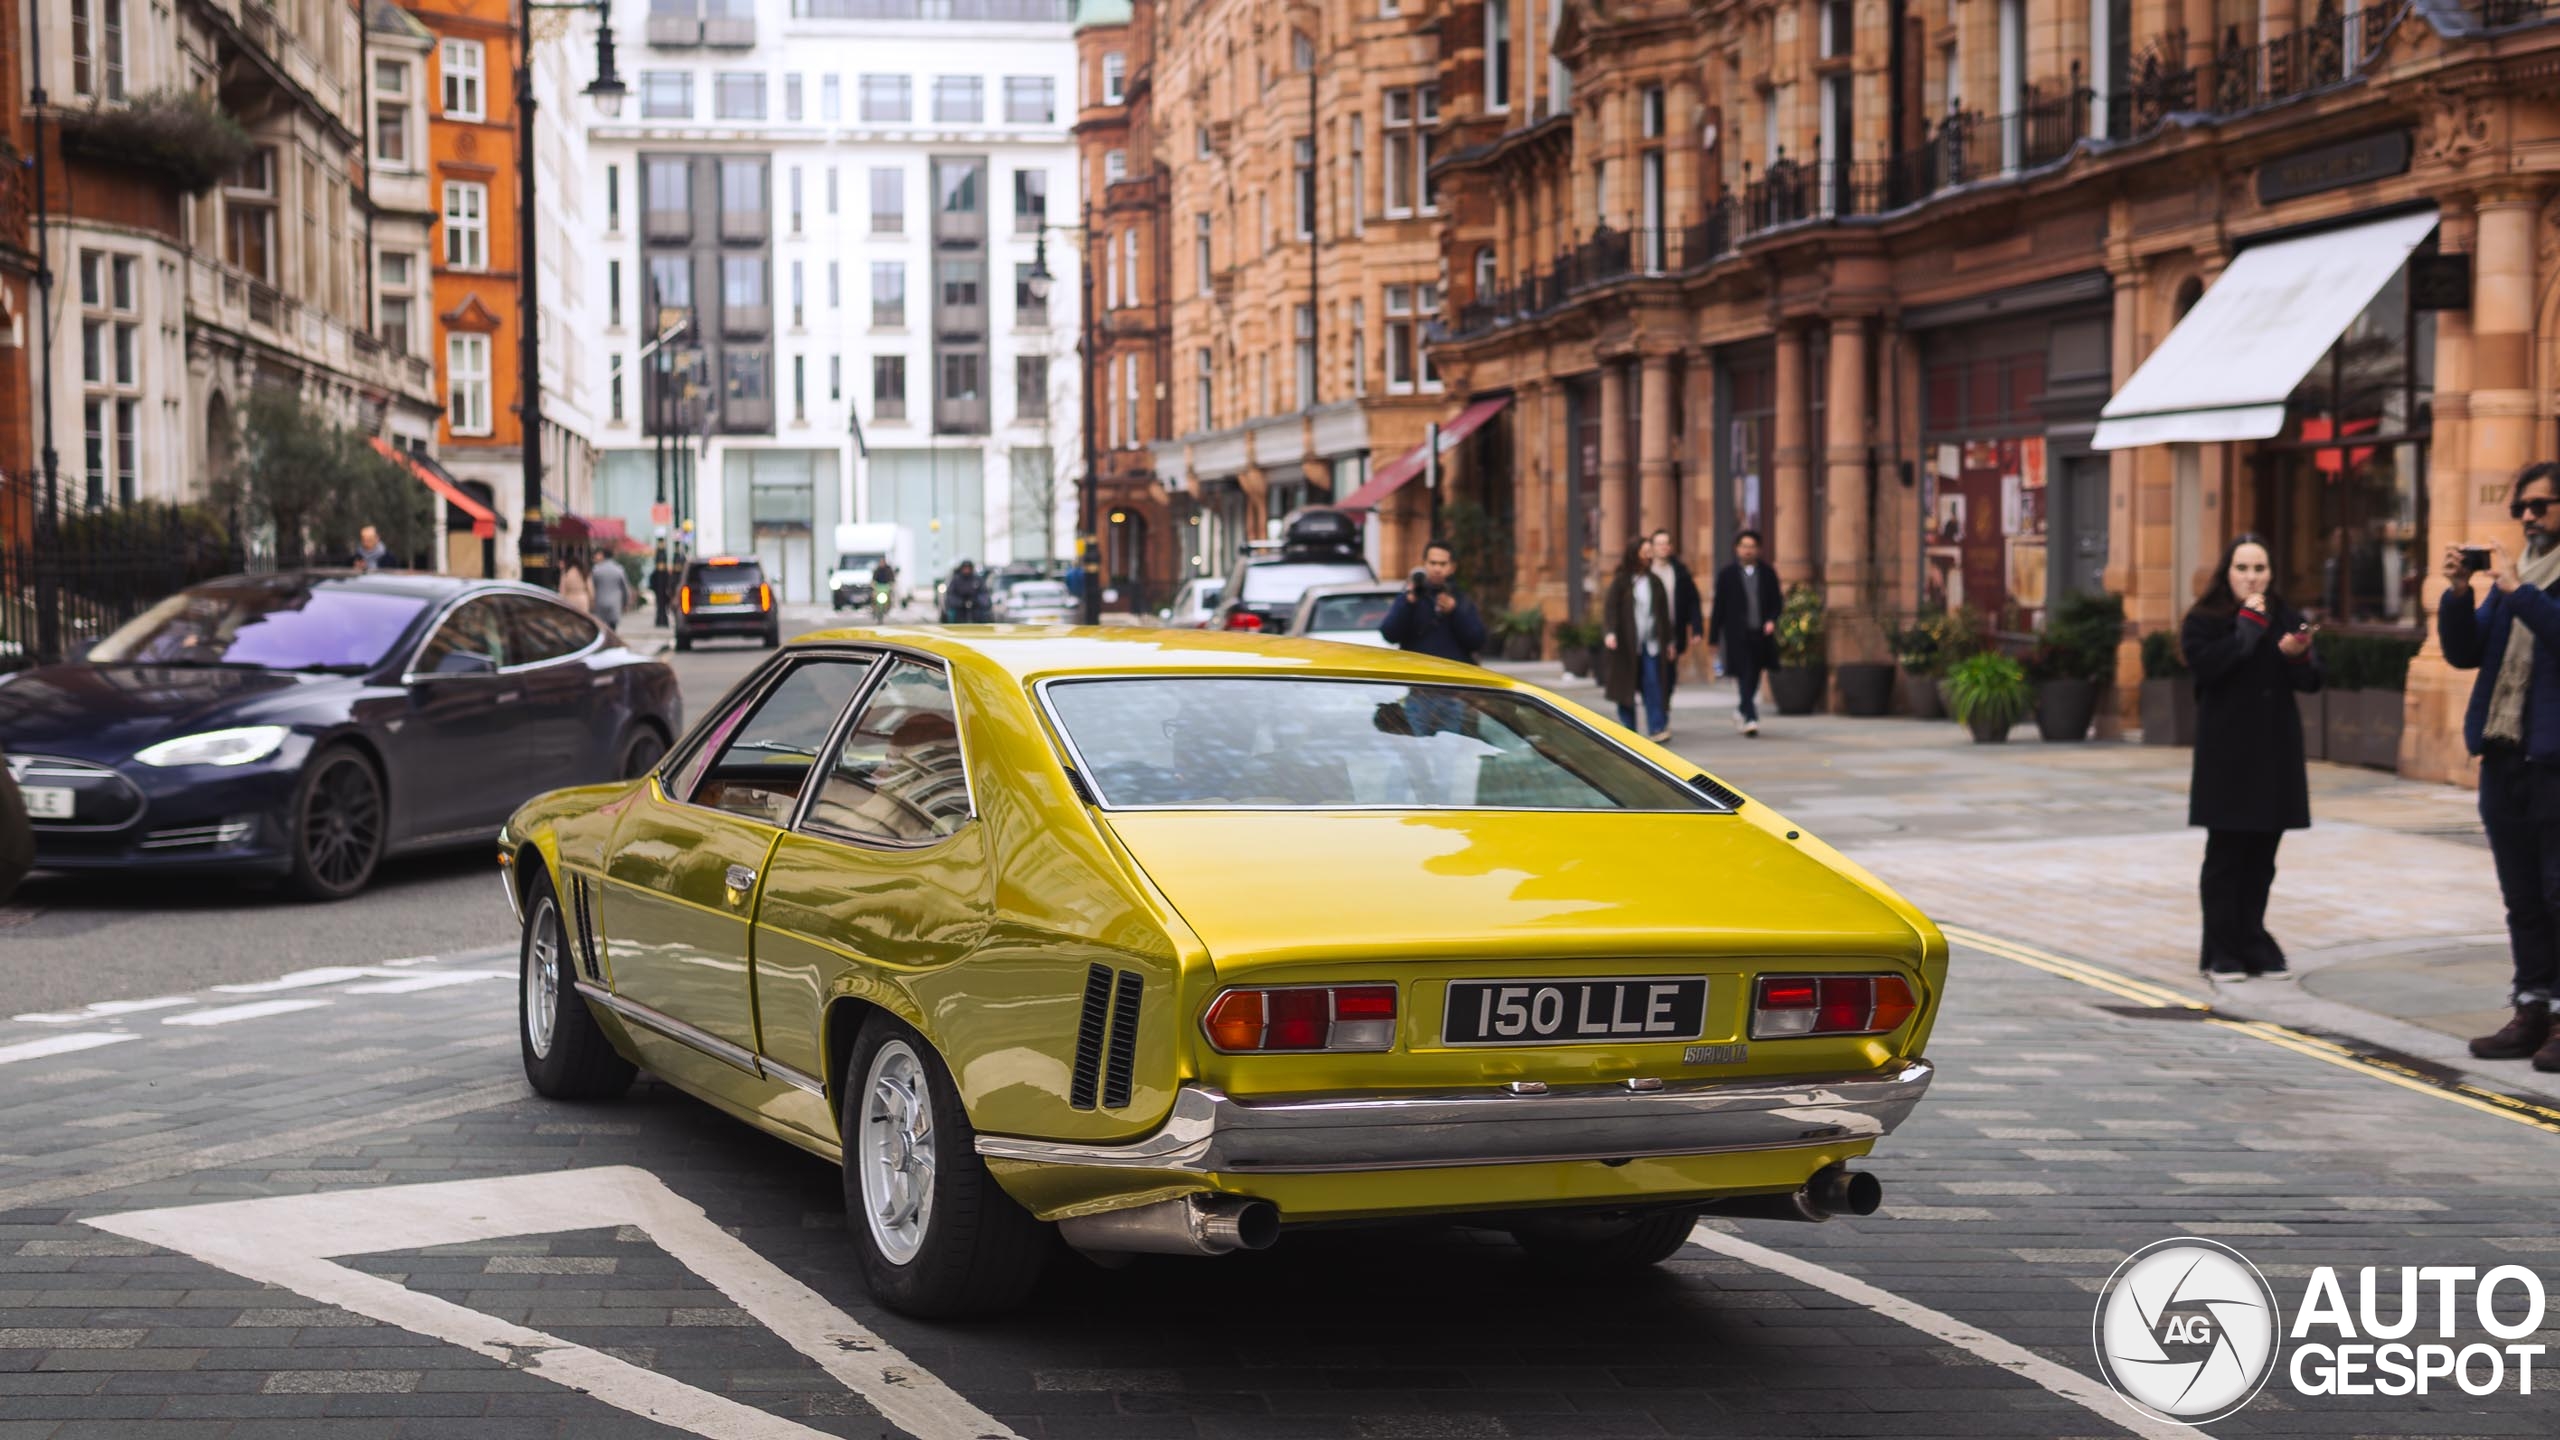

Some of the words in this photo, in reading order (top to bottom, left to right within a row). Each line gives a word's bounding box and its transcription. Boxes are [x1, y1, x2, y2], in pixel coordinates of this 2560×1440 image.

[2479, 483, 2511, 505] 117
[1478, 987, 1564, 1037] 150
[1577, 984, 1679, 1034] LLE
